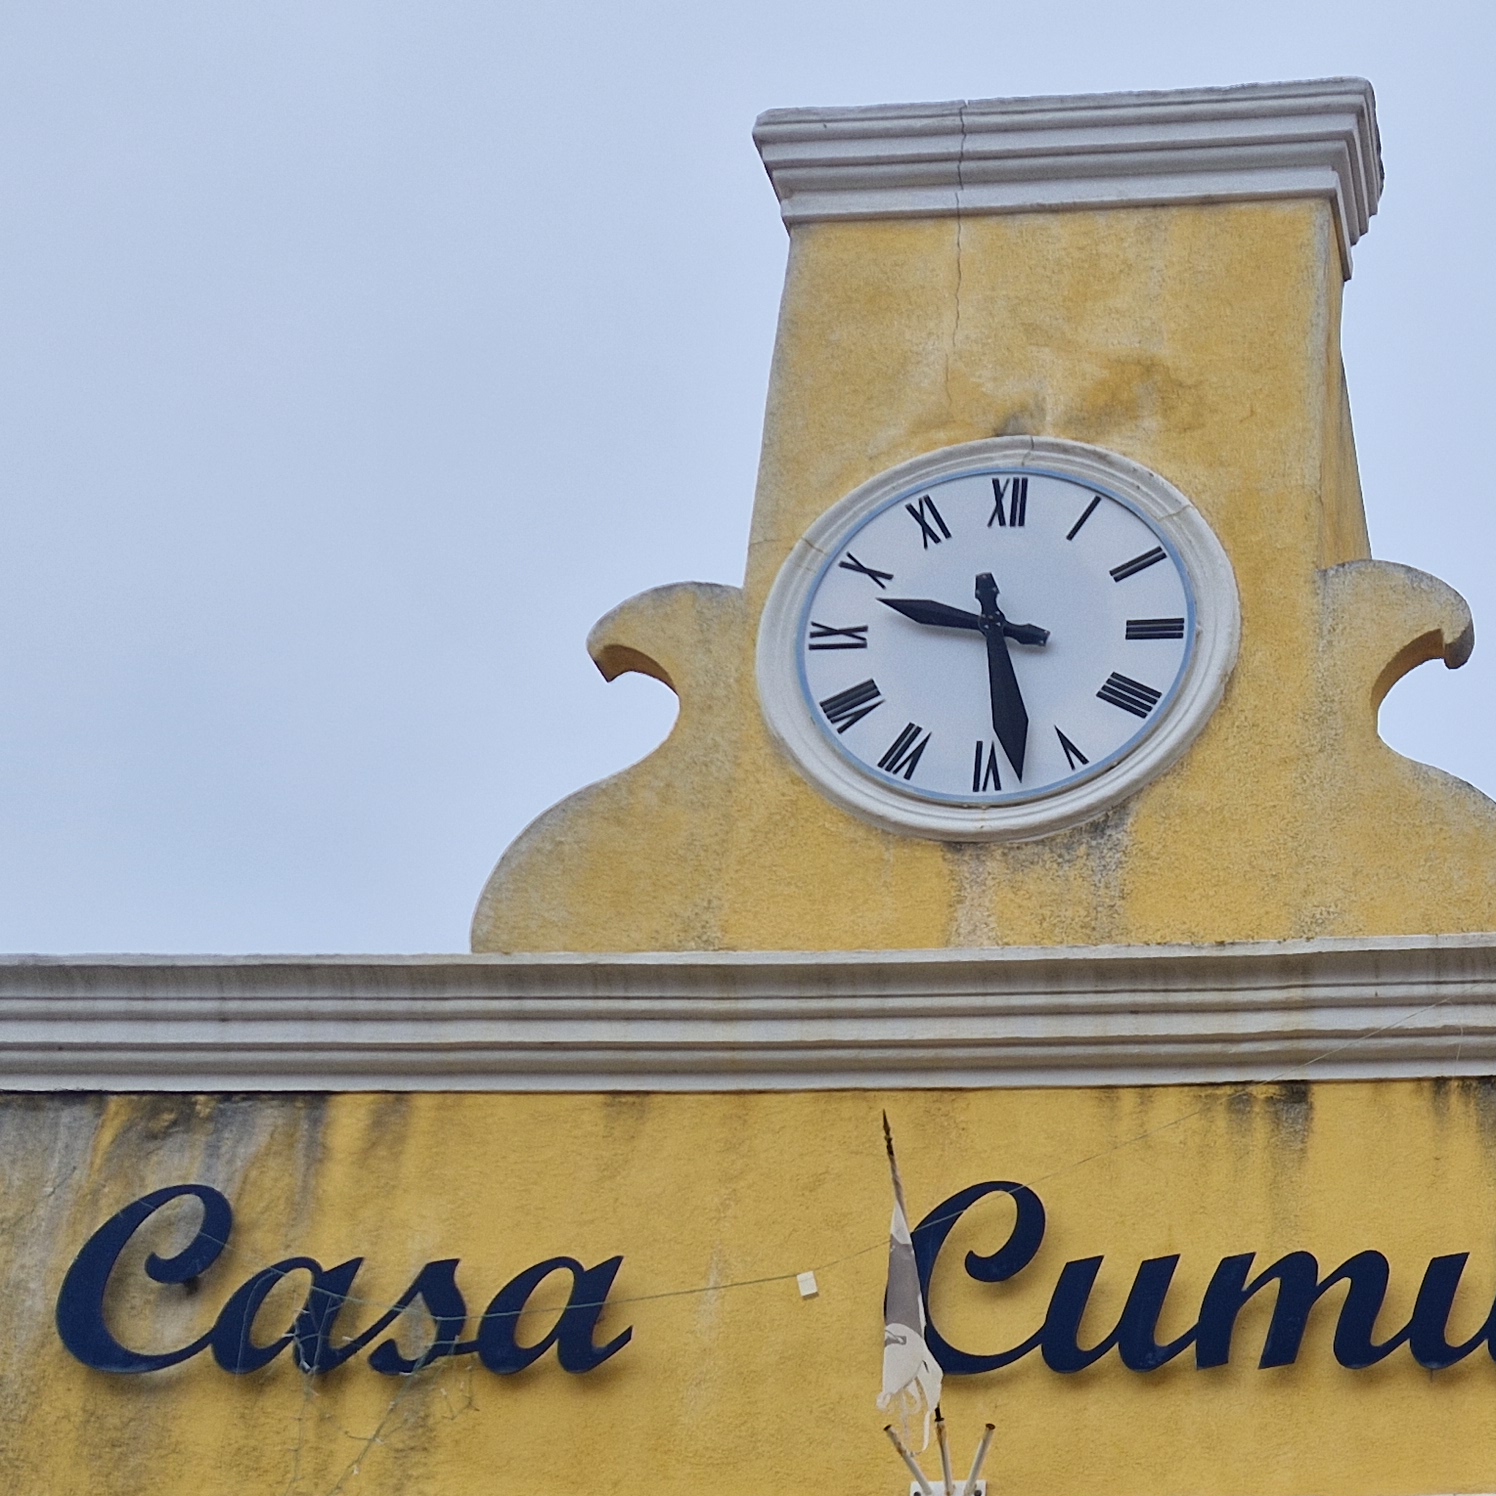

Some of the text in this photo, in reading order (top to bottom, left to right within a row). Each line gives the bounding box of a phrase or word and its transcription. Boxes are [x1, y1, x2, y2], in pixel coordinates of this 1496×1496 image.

[905, 494, 953, 550] XI
[988, 478, 1028, 527] XII
[839, 552, 894, 589] X
[808, 621, 868, 651] IX
[1125, 617, 1184, 640] III
[819, 678, 885, 733] VIII
[1096, 672, 1162, 718] IIII
[877, 722, 931, 780] VII
[973, 740, 1001, 792] VI
[1055, 725, 1089, 770] V
[55, 1183, 632, 1375] Casa
